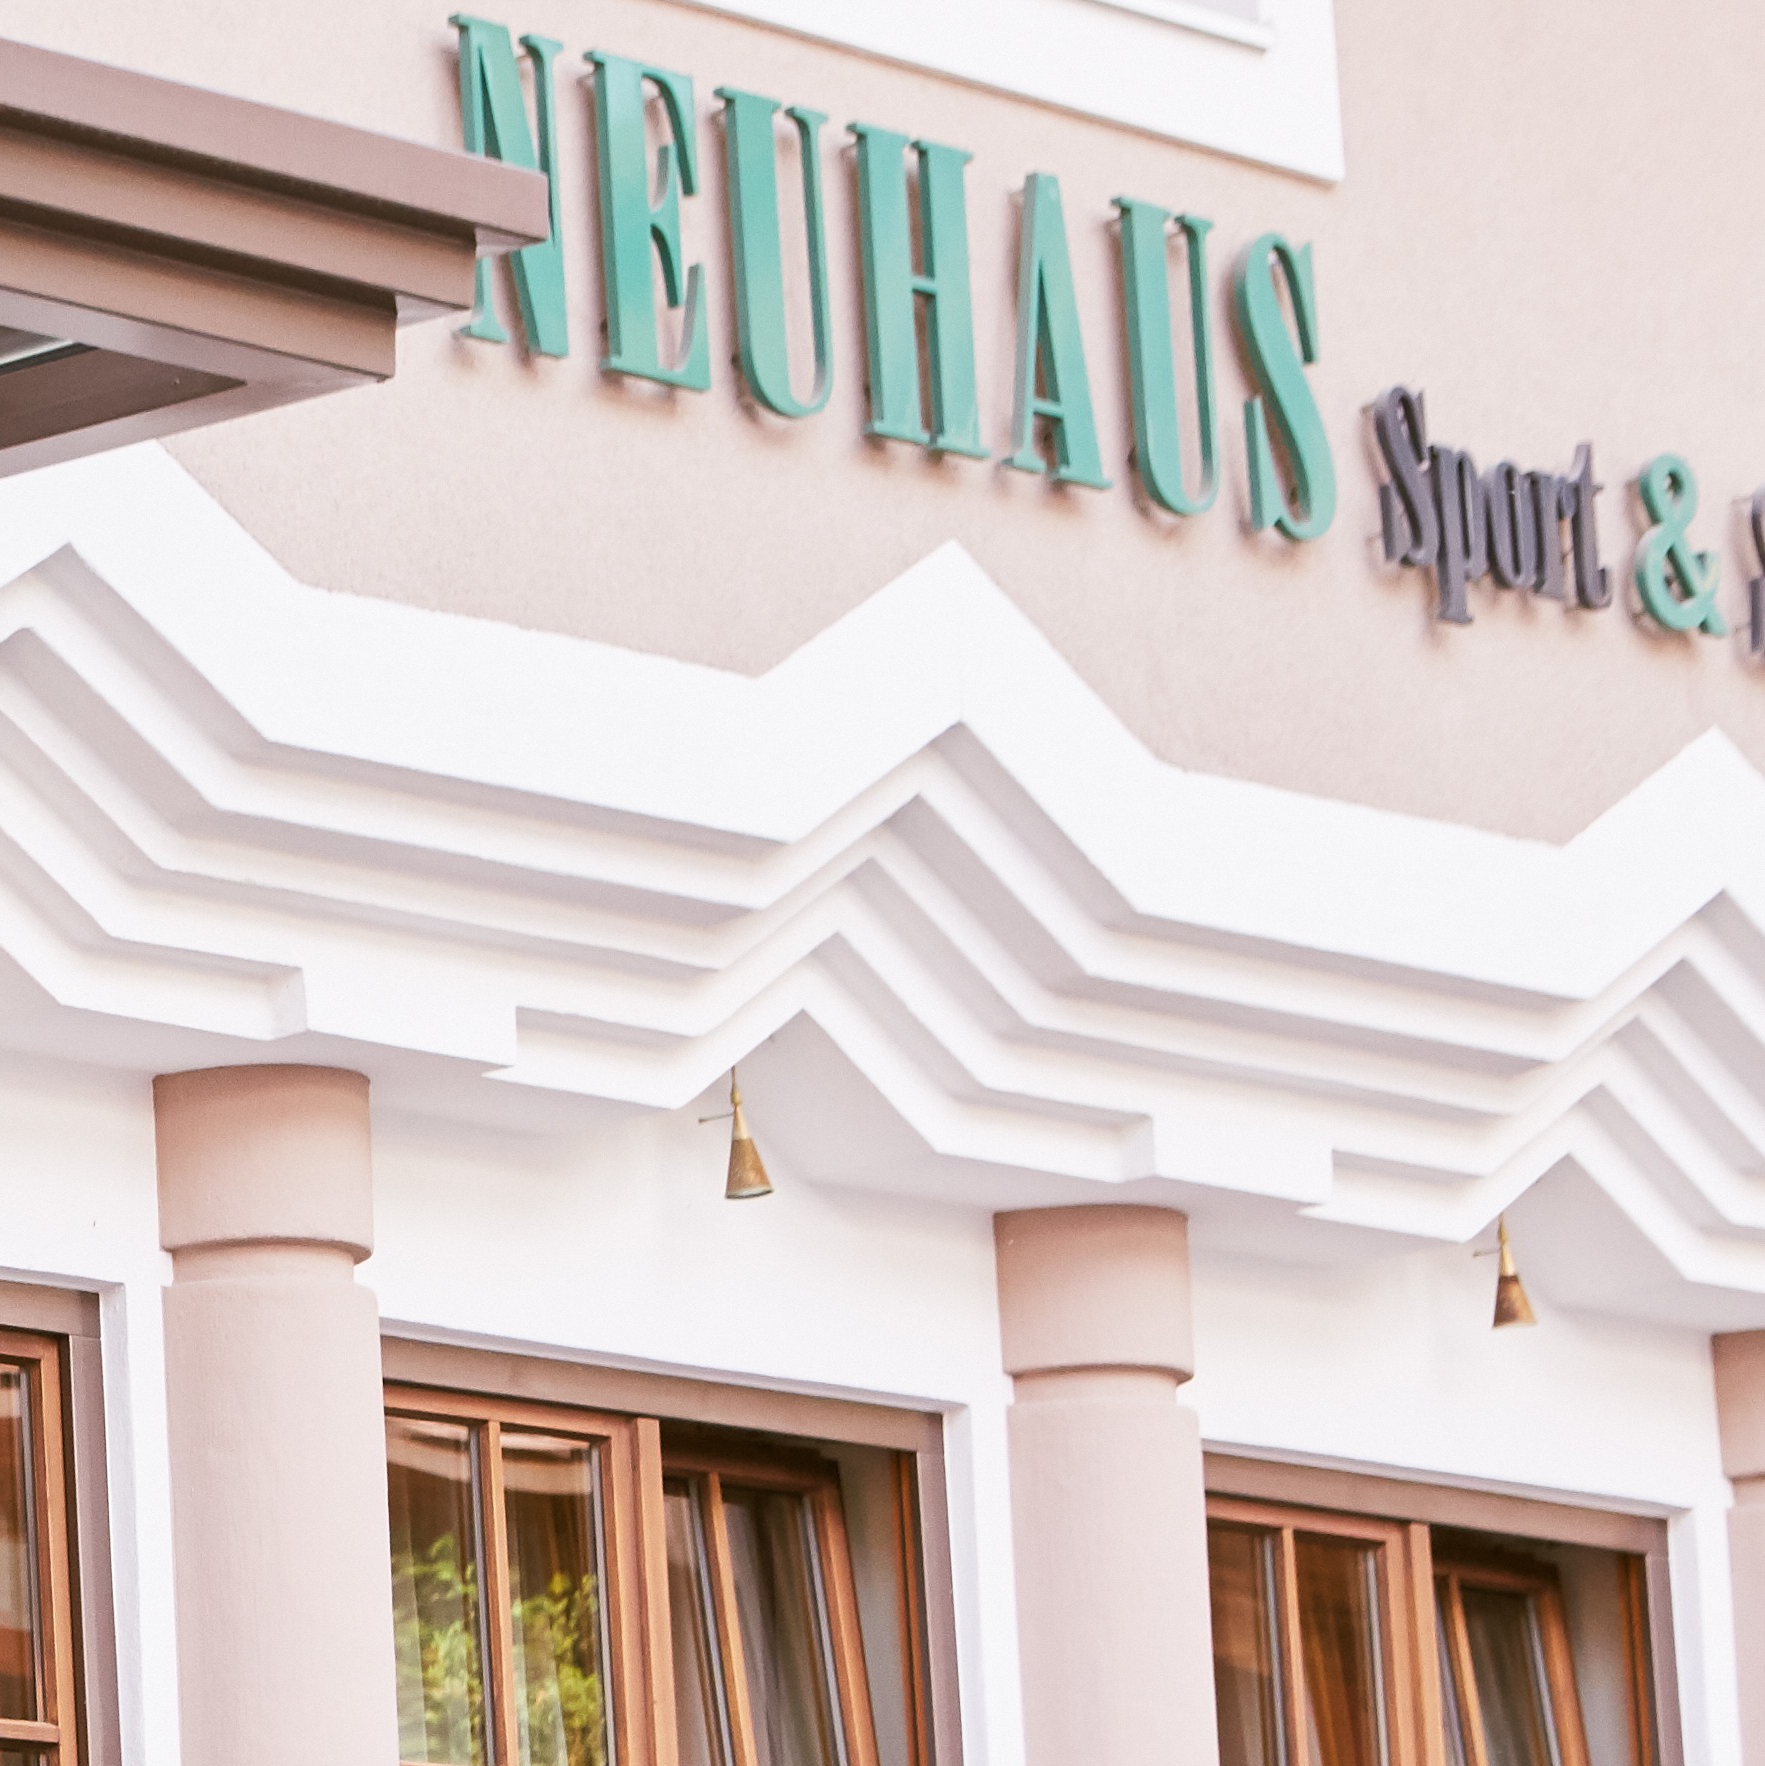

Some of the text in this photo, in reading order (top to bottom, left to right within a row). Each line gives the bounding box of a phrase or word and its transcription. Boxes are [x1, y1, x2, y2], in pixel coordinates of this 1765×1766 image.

[448, 13, 1337, 542] NEUHAUS
[1371, 386, 1612, 624] Sport
[1634, 453, 1728, 638] &
